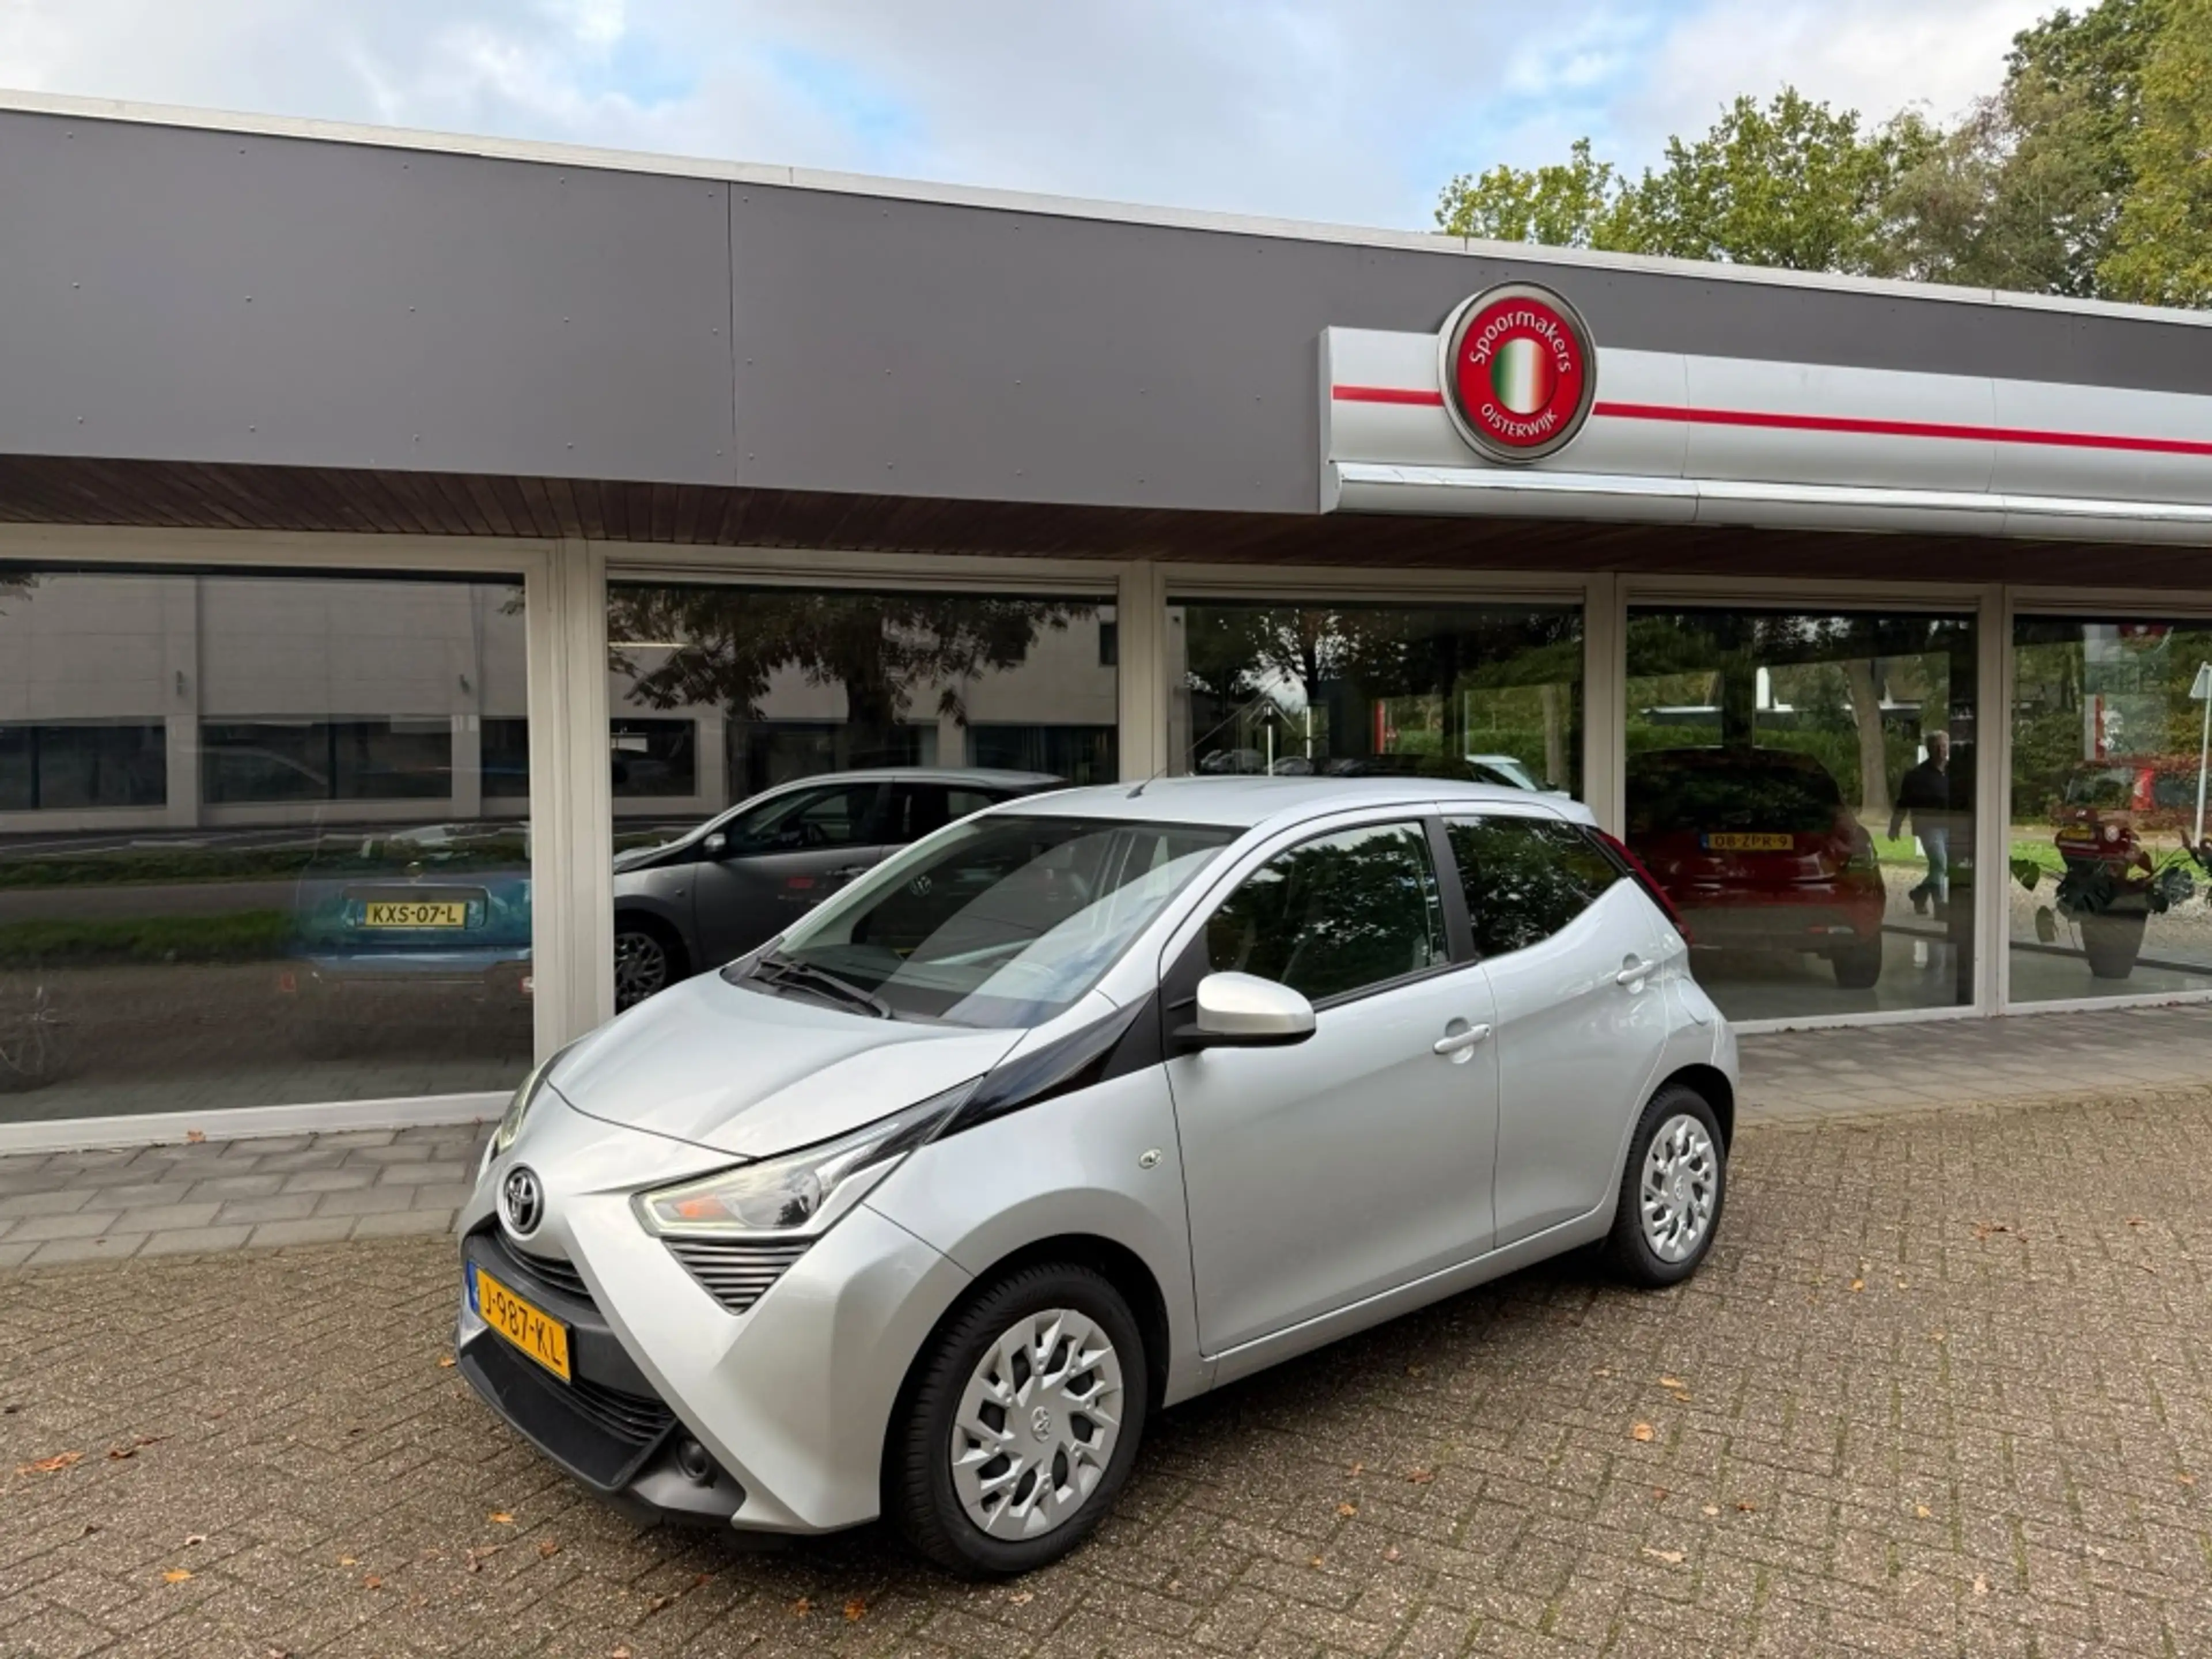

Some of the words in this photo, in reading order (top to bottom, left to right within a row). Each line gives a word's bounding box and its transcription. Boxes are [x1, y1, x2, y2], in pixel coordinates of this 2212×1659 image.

[1469, 311, 1571, 373] Spoormakers
[1481, 404, 1558, 437] OISTERWIJK
[373, 905, 457, 923] KXS-07-L
[486, 1282, 563, 1368] J-987-KL
